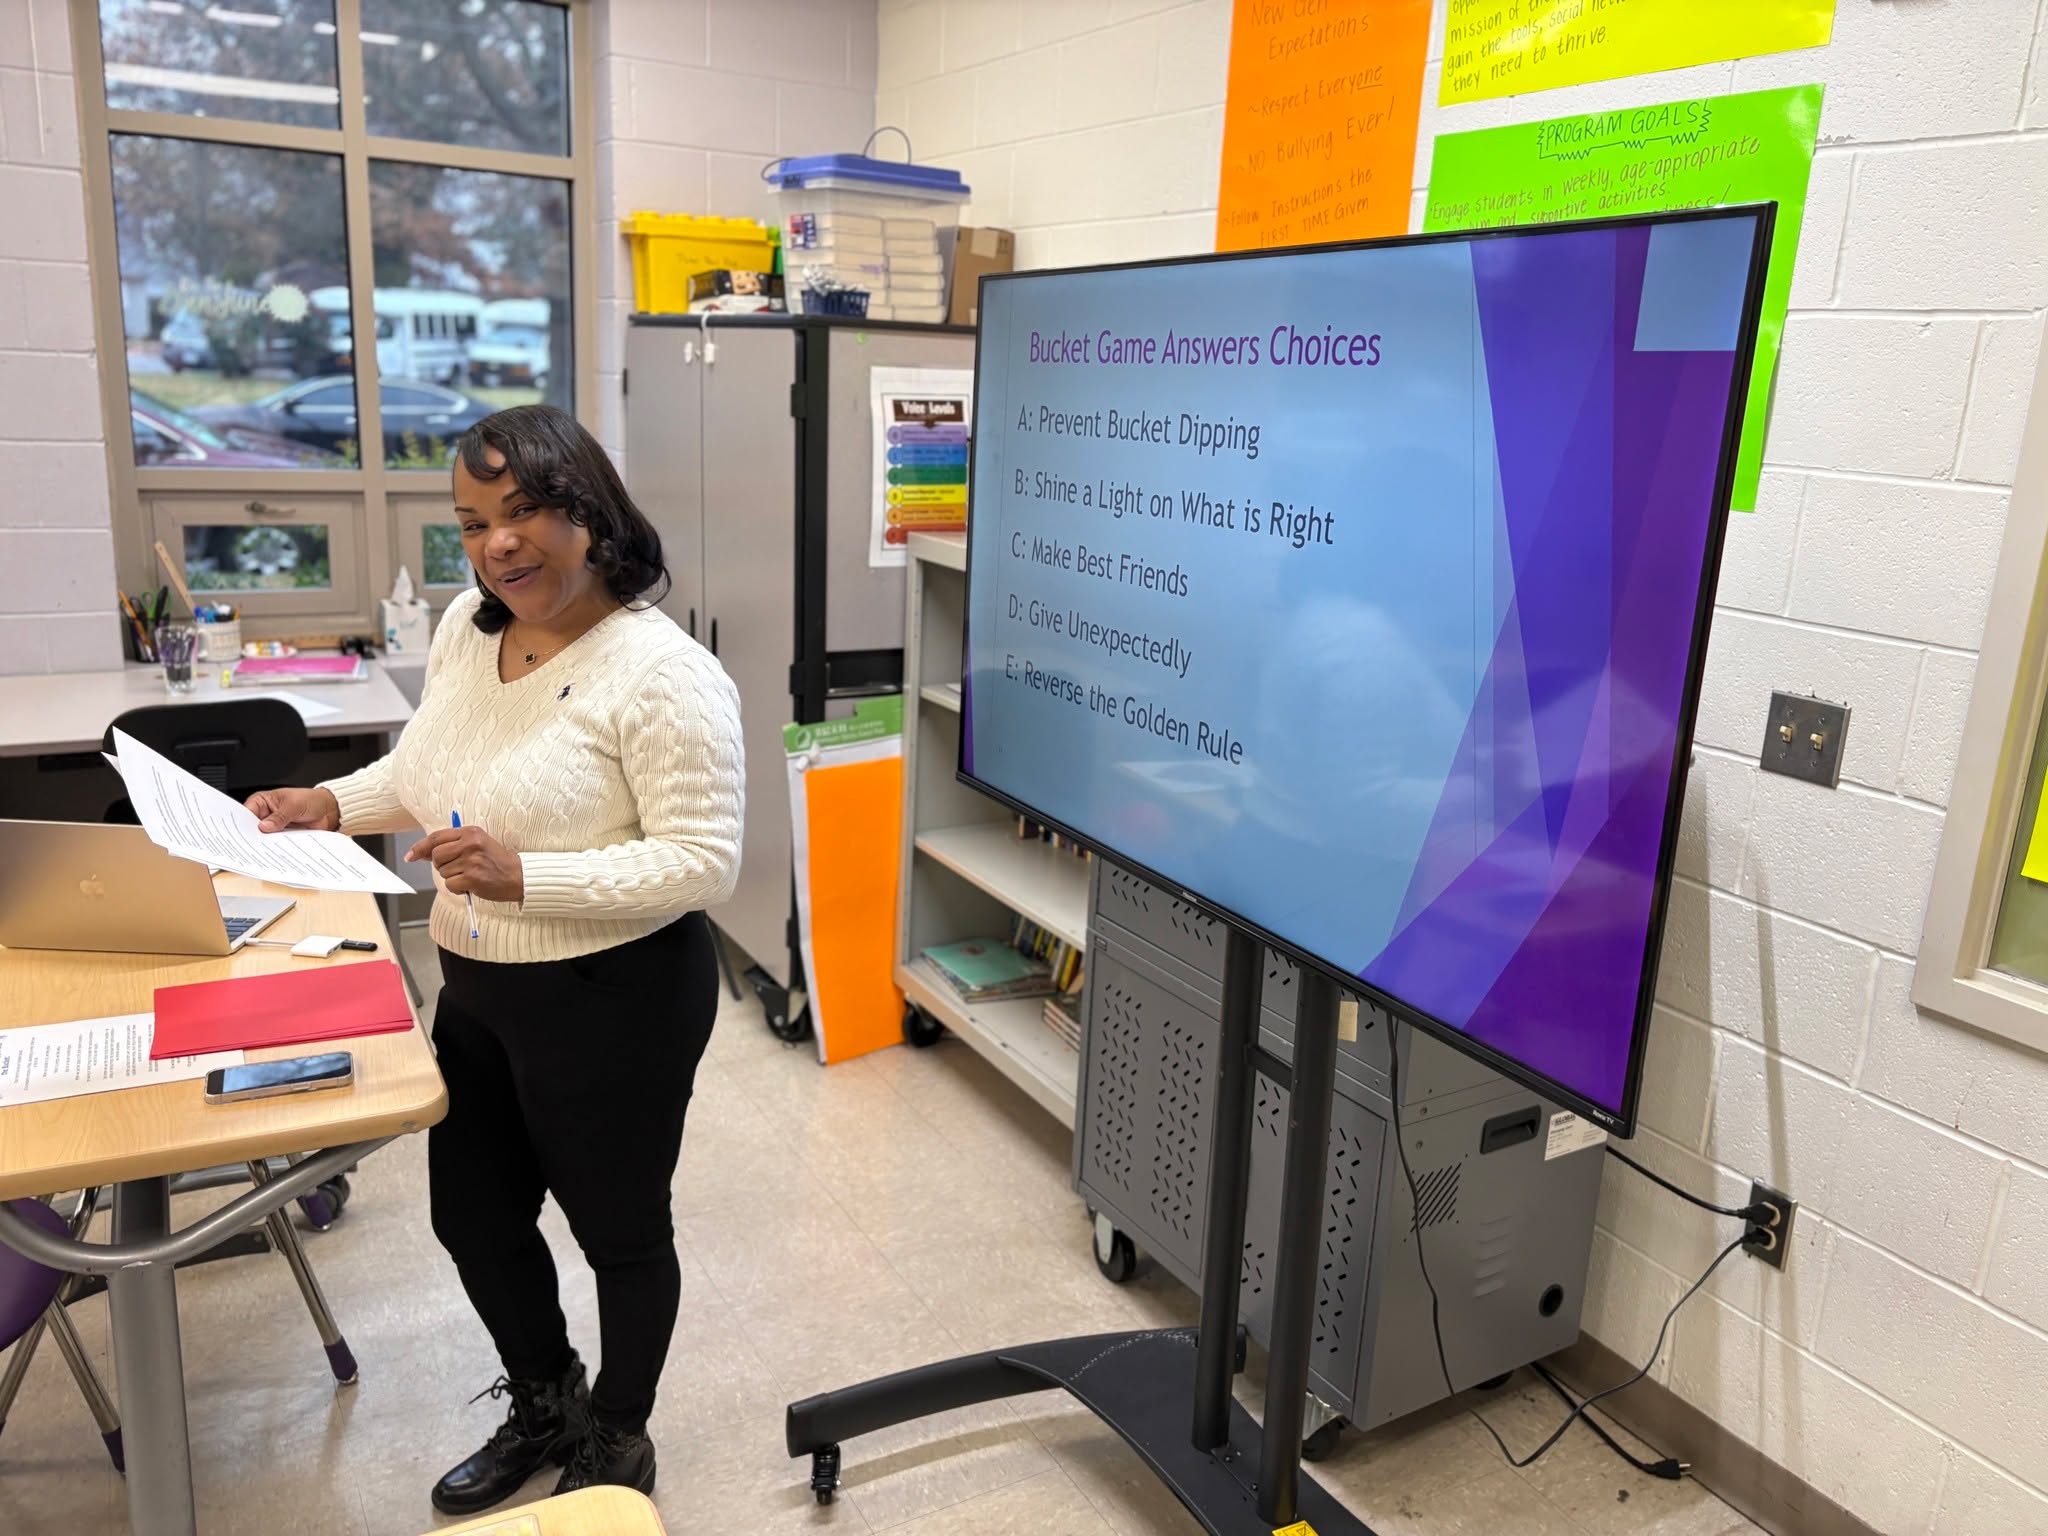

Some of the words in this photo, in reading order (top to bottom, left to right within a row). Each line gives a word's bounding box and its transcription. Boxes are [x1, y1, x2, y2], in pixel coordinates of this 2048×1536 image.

[1250, 1, 1285, 27] New
[1268, 14, 1369, 60] Expectations
[1450, 11, 1502, 44] mission
[1508, 0, 1520, 21] of
[1447, 50, 1473, 77] gain
[1482, 36, 1502, 58] the
[1548, 2, 1584, 28] social
[1318, 66, 1384, 98] Everyone
[1453, 69, 1480, 92] they
[1491, 52, 1523, 80] need
[1533, 46, 1547, 64] to
[1277, 131, 1334, 163] Bullying
[1545, 113, 1623, 151] PROGRAM
[1630, 101, 1700, 135] GOALS
[1271, 178, 1342, 218] Instructions
[1350, 167, 1373, 189] the
[1475, 189, 1534, 213] students
[1543, 184, 1553, 200] in
[1619, 134, 1761, 189] age-appropriate
[1261, 224, 1289, 247] FIRST
[1302, 208, 1330, 233] TIME
[1334, 196, 1369, 221] Given
[1530, 198, 1588, 225] supportive
[1029, 329, 1091, 364] Bucket
[1097, 329, 1156, 364] Game
[1161, 328, 1260, 366] Answers
[1269, 324, 1382, 367] Choices
[901, 401, 926, 415] Voice
[928, 401, 956, 416] Levels
[1016, 404, 1033, 432] A:
[1038, 405, 1102, 438] Prevent
[1107, 409, 1172, 444] Bucket
[1178, 412, 1261, 460] Dipping
[1014, 468, 1029, 496] B:
[1034, 471, 1078, 504] Shine
[1082, 483, 1093, 506] a
[1098, 479, 1144, 519] Light
[1149, 495, 1173, 519] on
[1180, 490, 1236, 530] What
[1243, 498, 1261, 533] is
[1269, 501, 1335, 549] Right
[1011, 531, 1026, 559] C:
[1031, 535, 1071, 570] Make
[1077, 544, 1113, 580] Best
[1119, 553, 1189, 597] Friends
[1008, 593, 1023, 622] D:
[1028, 599, 1063, 633] Give
[1068, 609, 1192, 678] Unexpectedly
[1005, 653, 1019, 682] E:
[1024, 660, 1084, 706] Reverse
[1089, 684, 1118, 719] the
[1122, 697, 1190, 747] Golden
[1196, 721, 1244, 766] Rule
